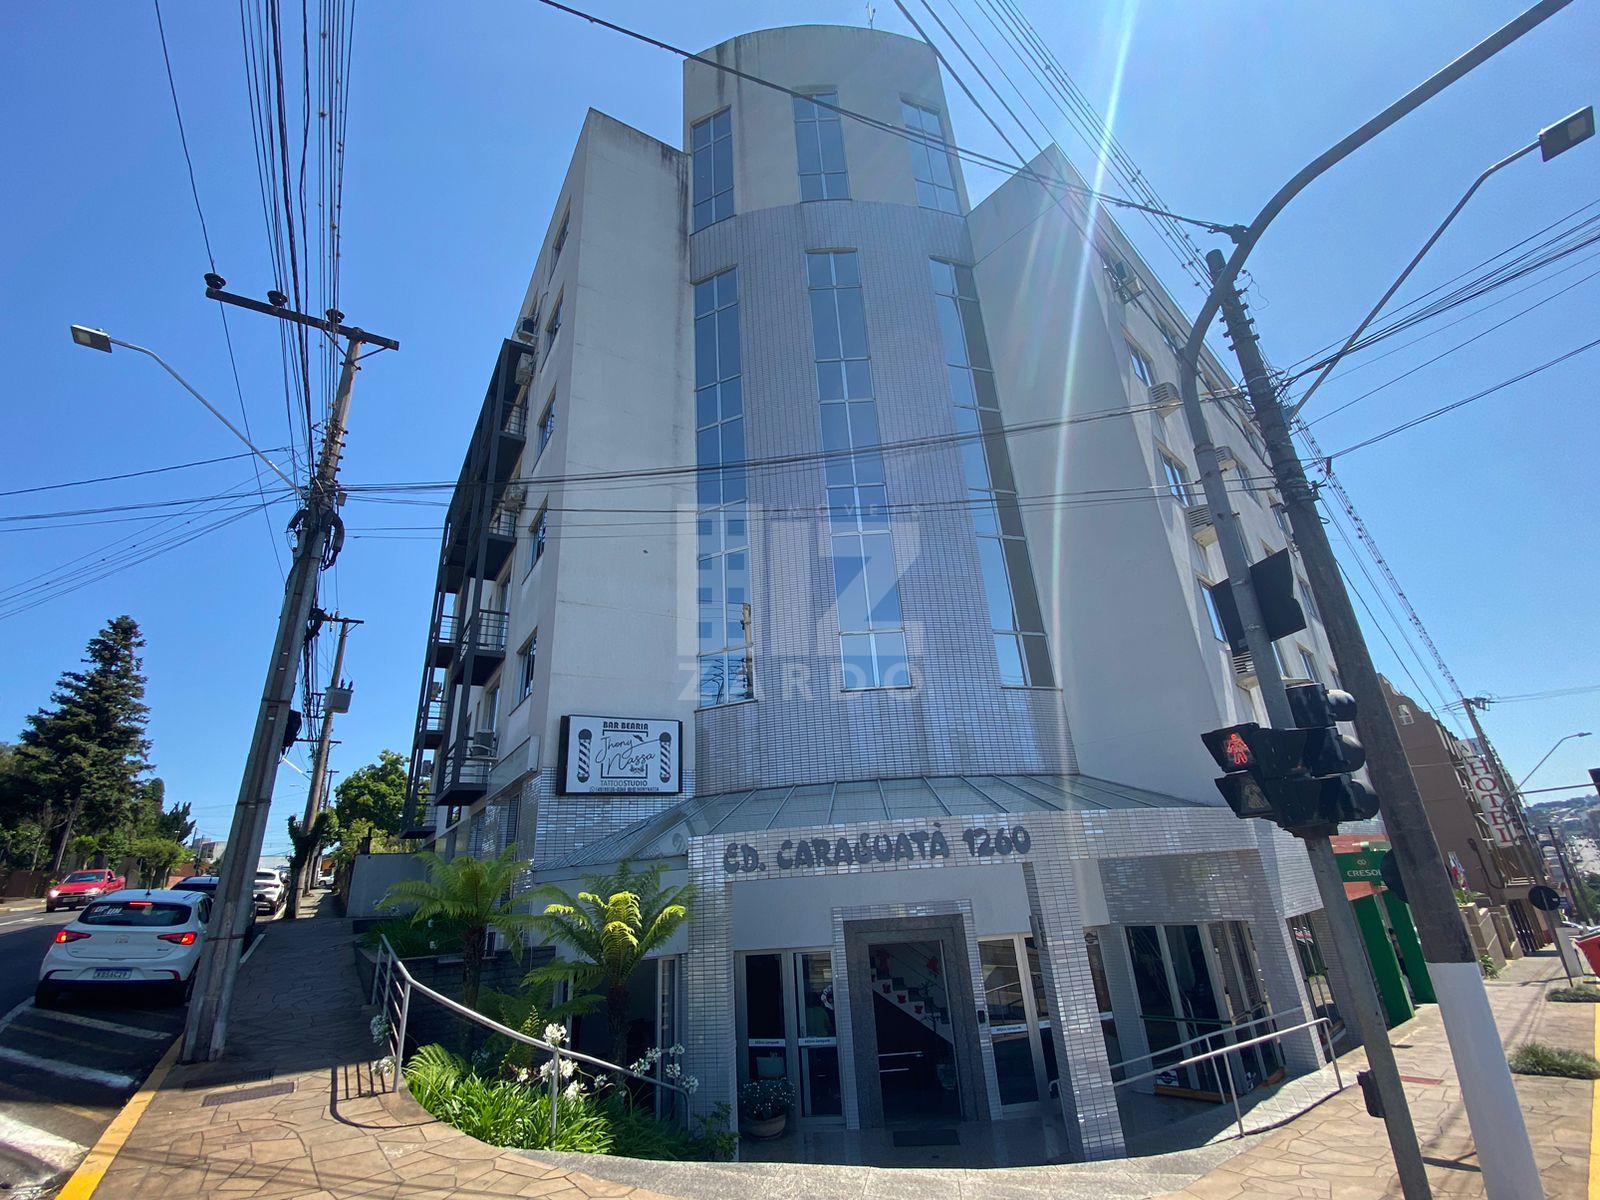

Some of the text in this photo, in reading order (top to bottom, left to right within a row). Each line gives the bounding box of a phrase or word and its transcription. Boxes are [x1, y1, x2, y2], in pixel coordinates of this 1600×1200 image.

[603, 721, 649, 730] BAR BEARIA
[1467, 757, 1513, 844] HOTEL
[723, 822, 1032, 874] ED. CARAGUATÁ 1260
